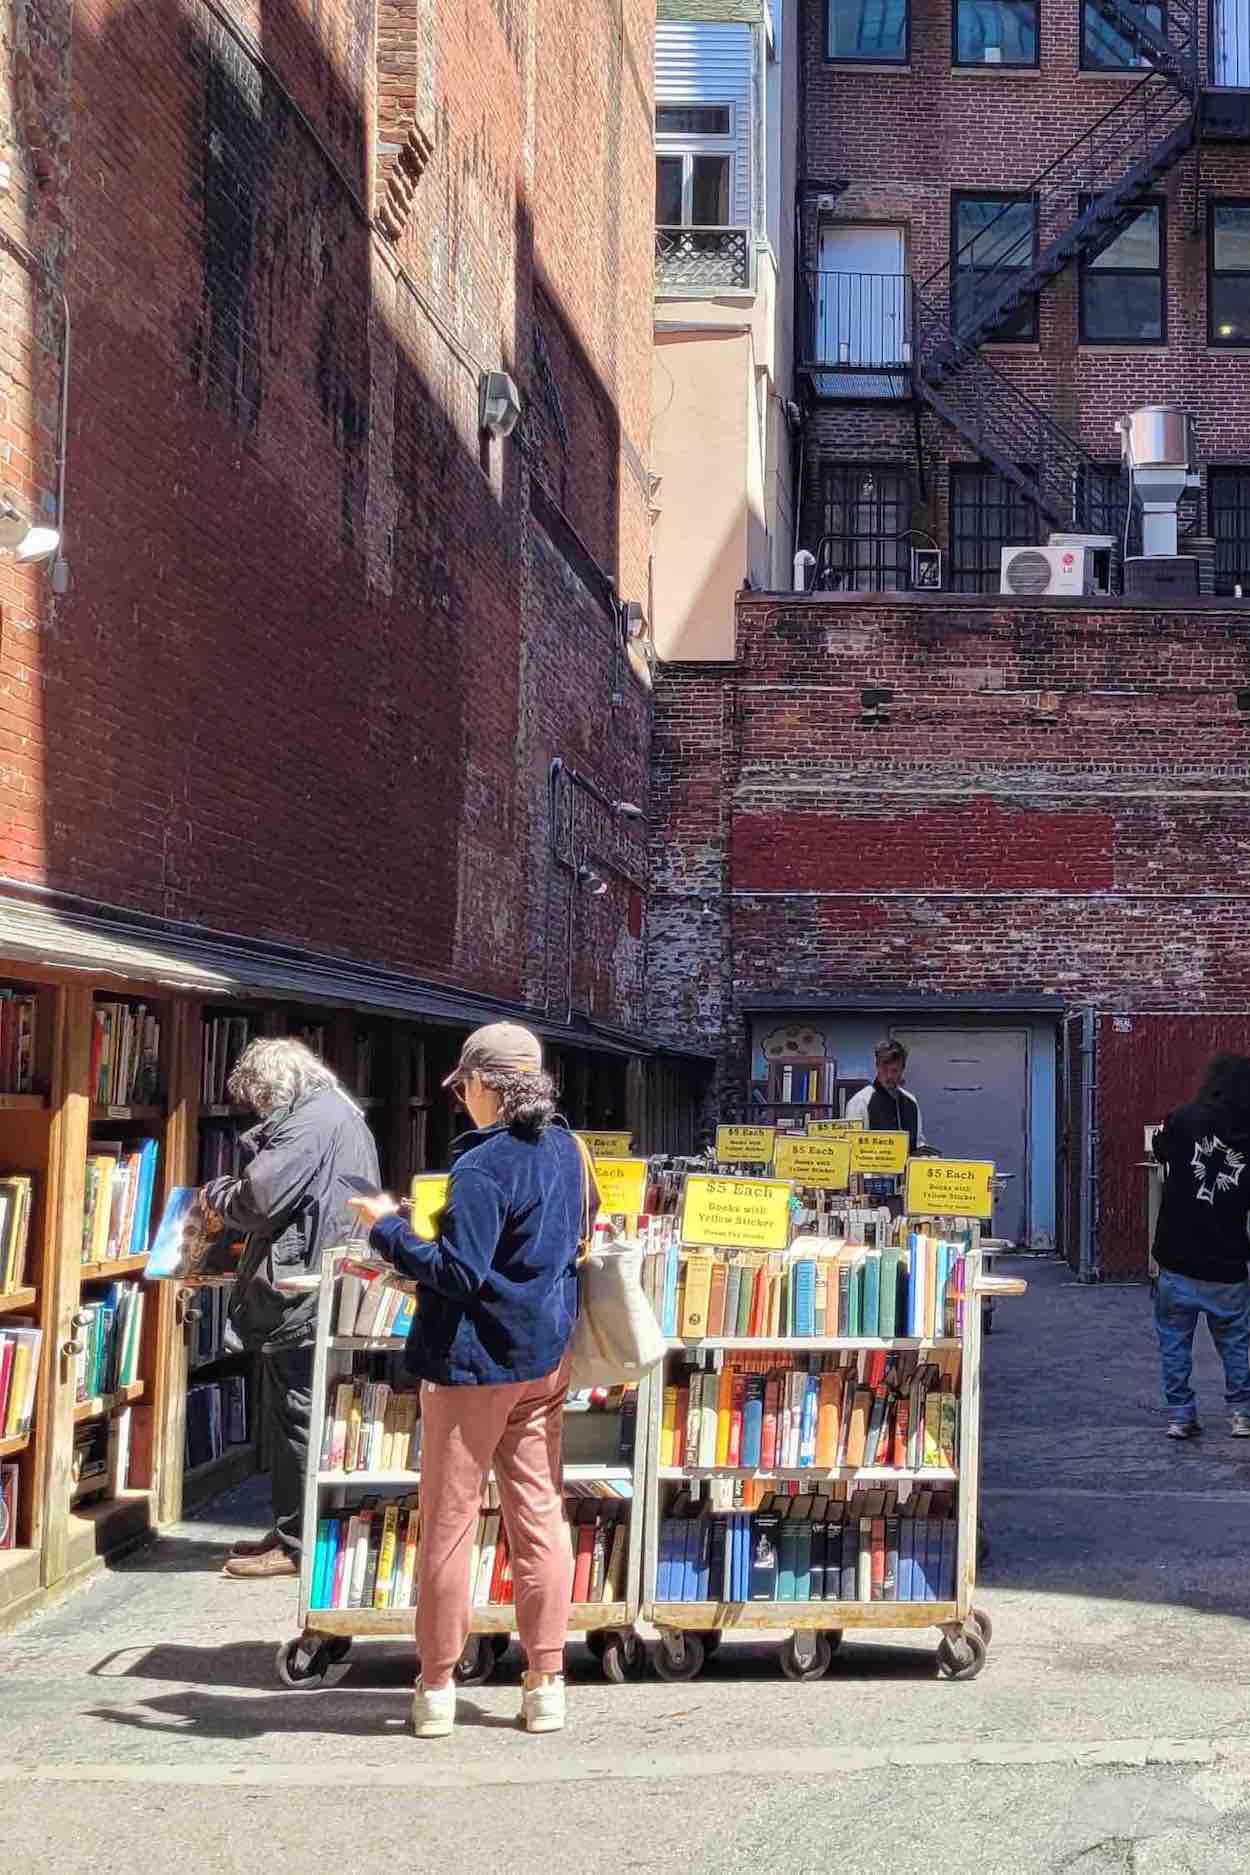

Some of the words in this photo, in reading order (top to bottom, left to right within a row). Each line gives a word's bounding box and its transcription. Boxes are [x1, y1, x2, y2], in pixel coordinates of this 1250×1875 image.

[792, 1145, 806, 1154] $5
[808, 1146, 834, 1156] Each
[927, 1168, 942, 1178] $5
[946, 1169, 975, 1180] Each
[706, 1181, 728, 1194] $5
[733, 1182, 773, 1198] Each
[708, 1201, 740, 1213] Books
[744, 1204, 768, 1214] with
[698, 1212, 734, 1224] Yellow
[735, 1218, 774, 1228] Sticker
